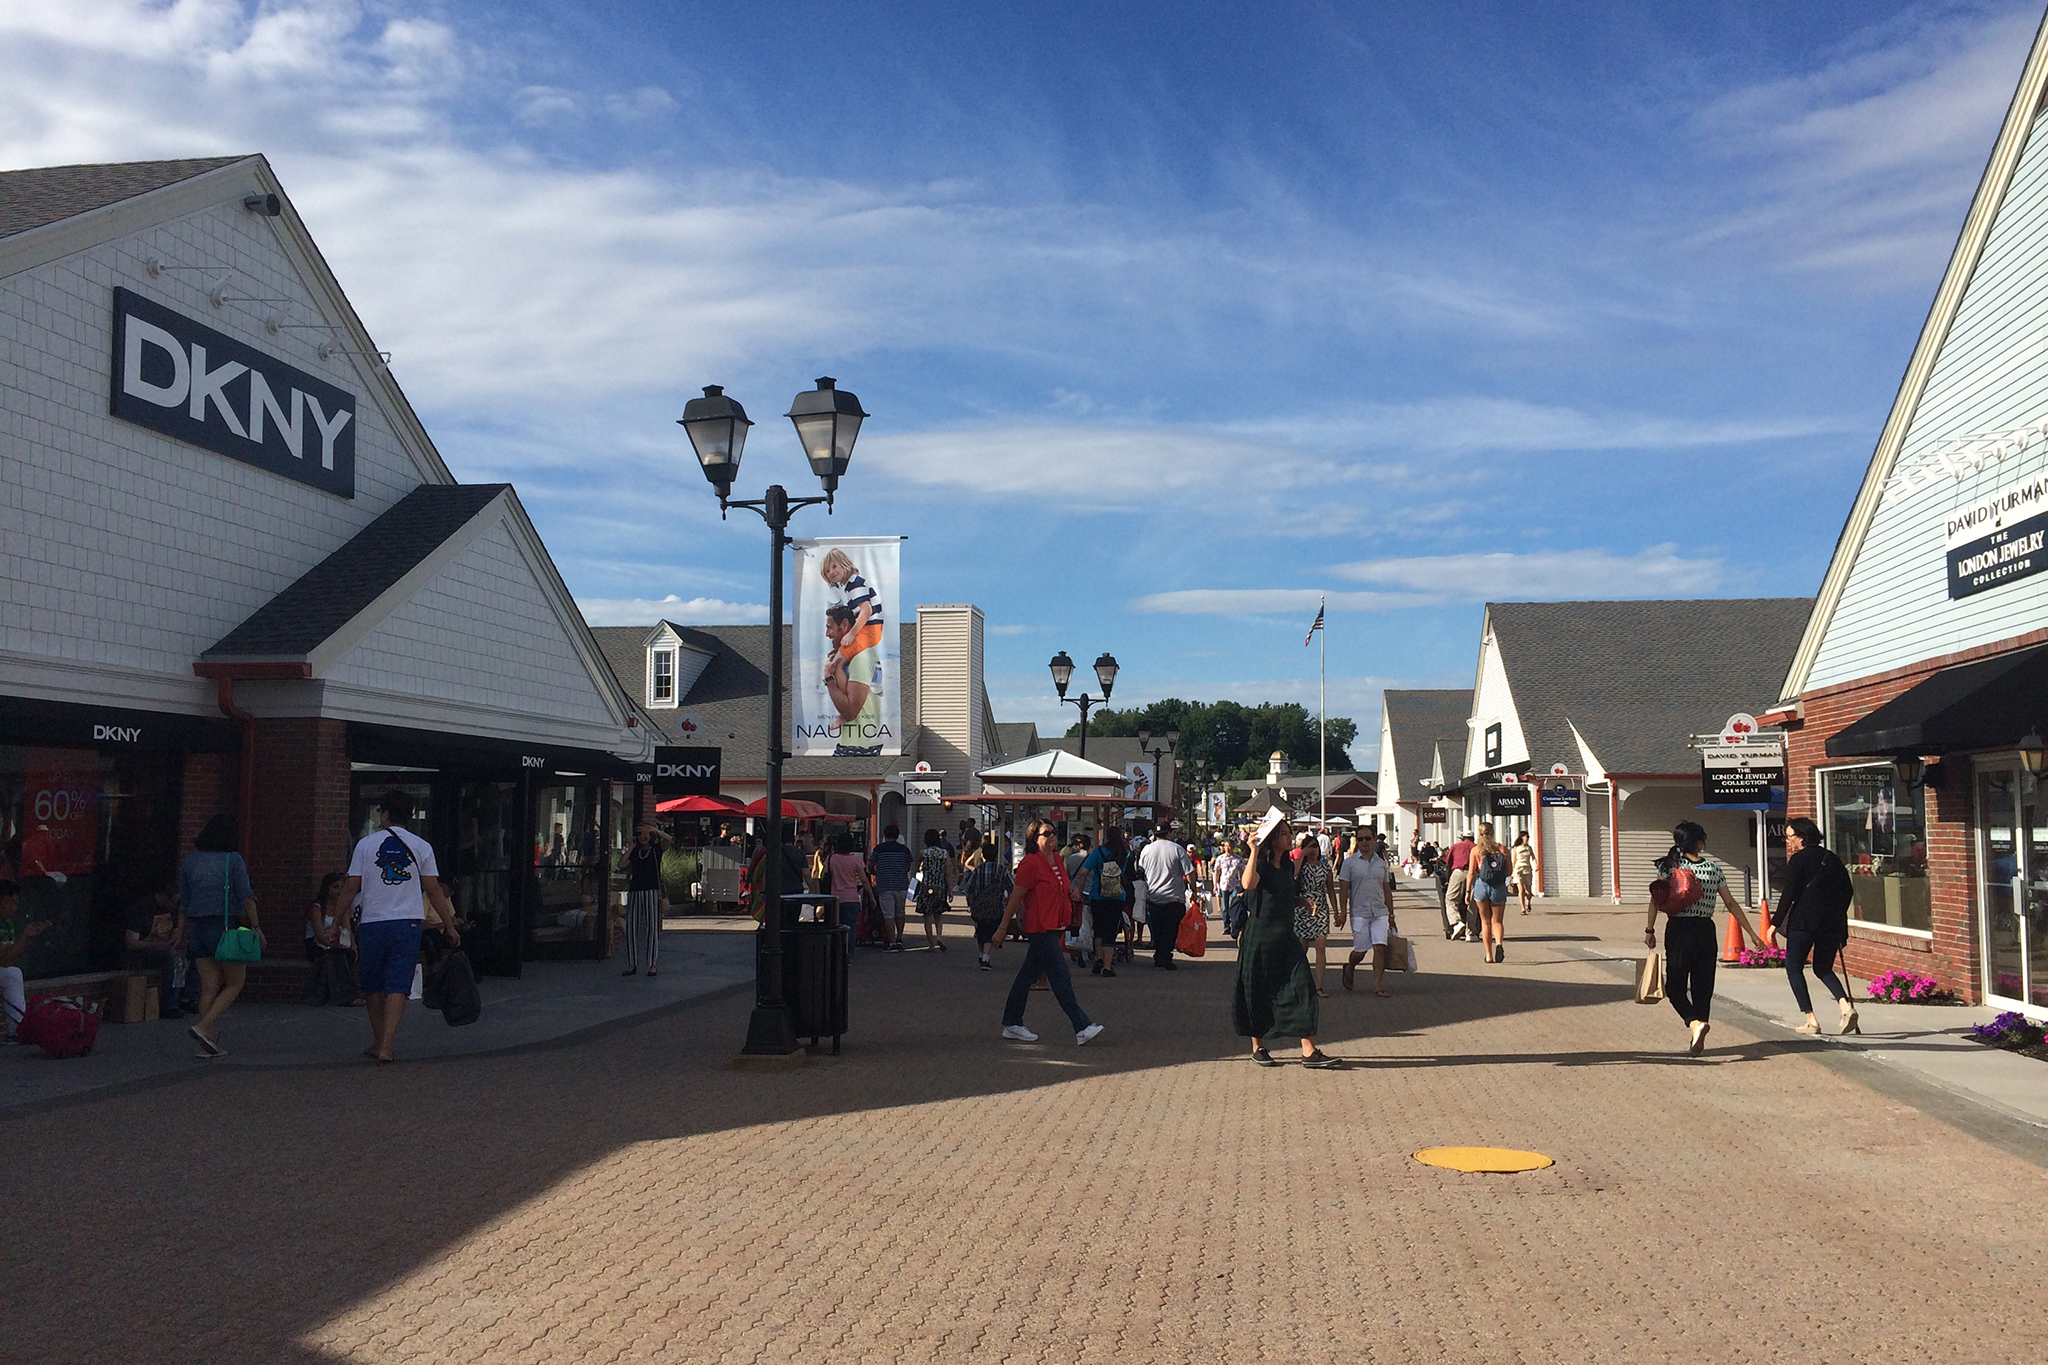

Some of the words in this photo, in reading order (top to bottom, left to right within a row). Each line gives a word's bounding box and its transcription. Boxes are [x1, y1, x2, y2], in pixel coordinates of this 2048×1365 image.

[123, 313, 353, 471] DKNY
[1948, 506, 1988, 537] DAVID
[1990, 531, 2009, 545] THE
[1957, 547, 1998, 578] LONDON
[1998, 529, 2045, 563] JEWELRY
[1973, 559, 2031, 586] COLLECTION
[93, 724, 142, 742] DKNY
[796, 723, 892, 739] NAUTICA
[522, 755, 546, 769] DKNY
[636, 773, 652, 782] DKNY
[656, 764, 717, 778] DKNY
[1025, 785, 1038, 794] NY
[1039, 785, 1072, 794] SHADES
[34, 789, 87, 821] 60%
[1497, 798, 1525, 806] ARMANI
[69, 811, 85, 821] OFF
[44, 828, 74, 839] TODAY
